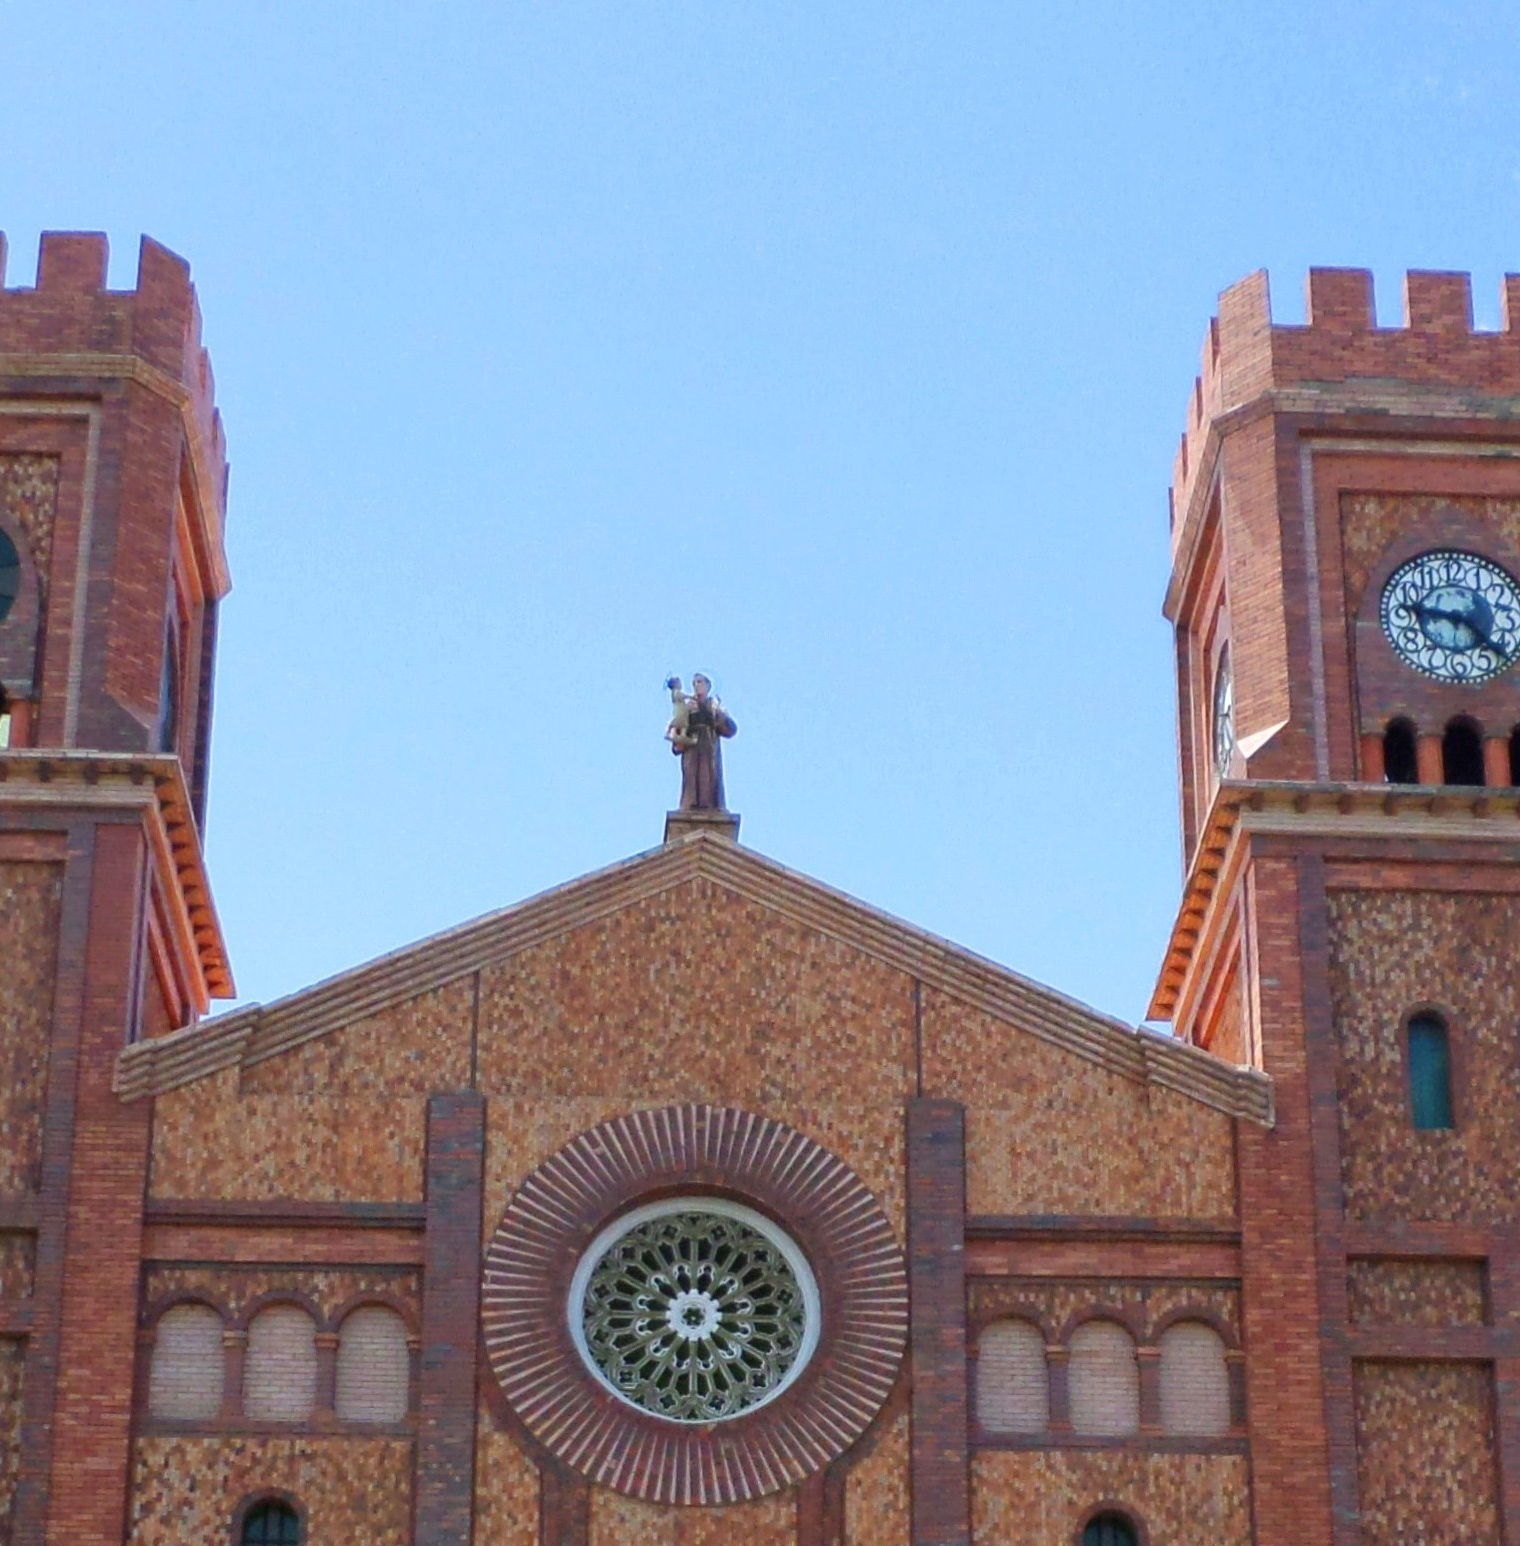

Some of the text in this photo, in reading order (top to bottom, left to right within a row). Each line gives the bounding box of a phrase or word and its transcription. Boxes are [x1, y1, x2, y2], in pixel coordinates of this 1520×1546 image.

[1418, 566, 1434, 589] 11
[1443, 561, 1462, 583] 12
[1400, 583, 1419, 603] 10
[1491, 585, 1511, 610] 2
[1395, 605, 1411, 628] 9
[1500, 608, 1515, 632] 3
[1404, 628, 1418, 653] 8
[1451, 652, 1468, 675] 6
[1478, 644, 1492, 671] 5
